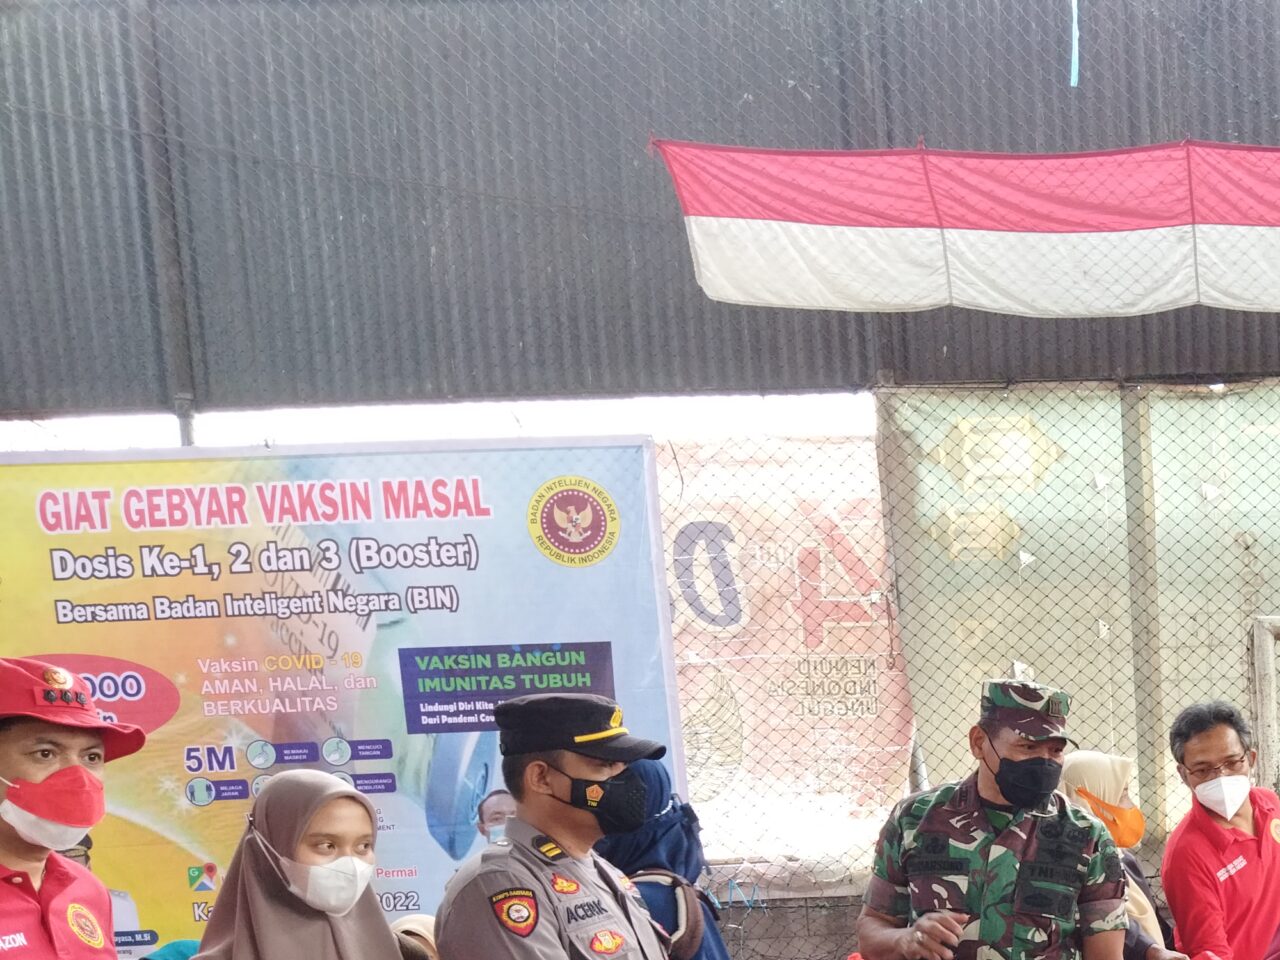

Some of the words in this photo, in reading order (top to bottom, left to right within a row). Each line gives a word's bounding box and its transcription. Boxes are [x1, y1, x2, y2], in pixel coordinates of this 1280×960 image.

[38, 489, 112, 533] GIAT
[122, 485, 249, 530] GEBYAR
[255, 480, 373, 524] VAKSIN
[381, 477, 492, 520] MASAL
[530, 493, 545, 524] BADAN
[544, 479, 591, 494] INTELIJEN
[592, 486, 617, 522] NEGARA
[50, 547, 134, 580] Dosis
[140, 543, 221, 581] Ke-1,
[228, 542, 252, 574] 2
[259, 541, 312, 572] dan
[318, 539, 341, 571] 3
[349, 534, 479, 574] (Booster)
[536, 535, 577, 564] REPUBLIK
[578, 531, 617, 565] INDONESIA
[54, 599, 151, 624] Bersama
[153, 594, 220, 620] Badan
[223, 590, 324, 619] Inteligent
[327, 589, 402, 615] Negara
[406, 585, 459, 614] (BIN)
[197, 656, 259, 674] Vaksin
[263, 654, 325, 671] COVID
[342, 652, 362, 668] 19
[415, 654, 492, 671] VAKSIN
[497, 651, 586, 668] BANGUN
[201, 678, 264, 695] AMAN,
[268, 675, 338, 692] HALAL,
[344, 673, 377, 689] dan
[417, 675, 516, 693] IMUNITAS
[521, 672, 591, 689] TUBUH
[203, 696, 338, 716] BERKUALITAS
[420, 702, 457, 713] Lindungi
[458, 701, 474, 711] Diri
[475, 701, 494, 710] Kita
[421, 715, 440, 724] Dari
[441, 714, 478, 724] Pandemi
[185, 746, 236, 772] 5M
[376, 867, 417, 879] Permai
